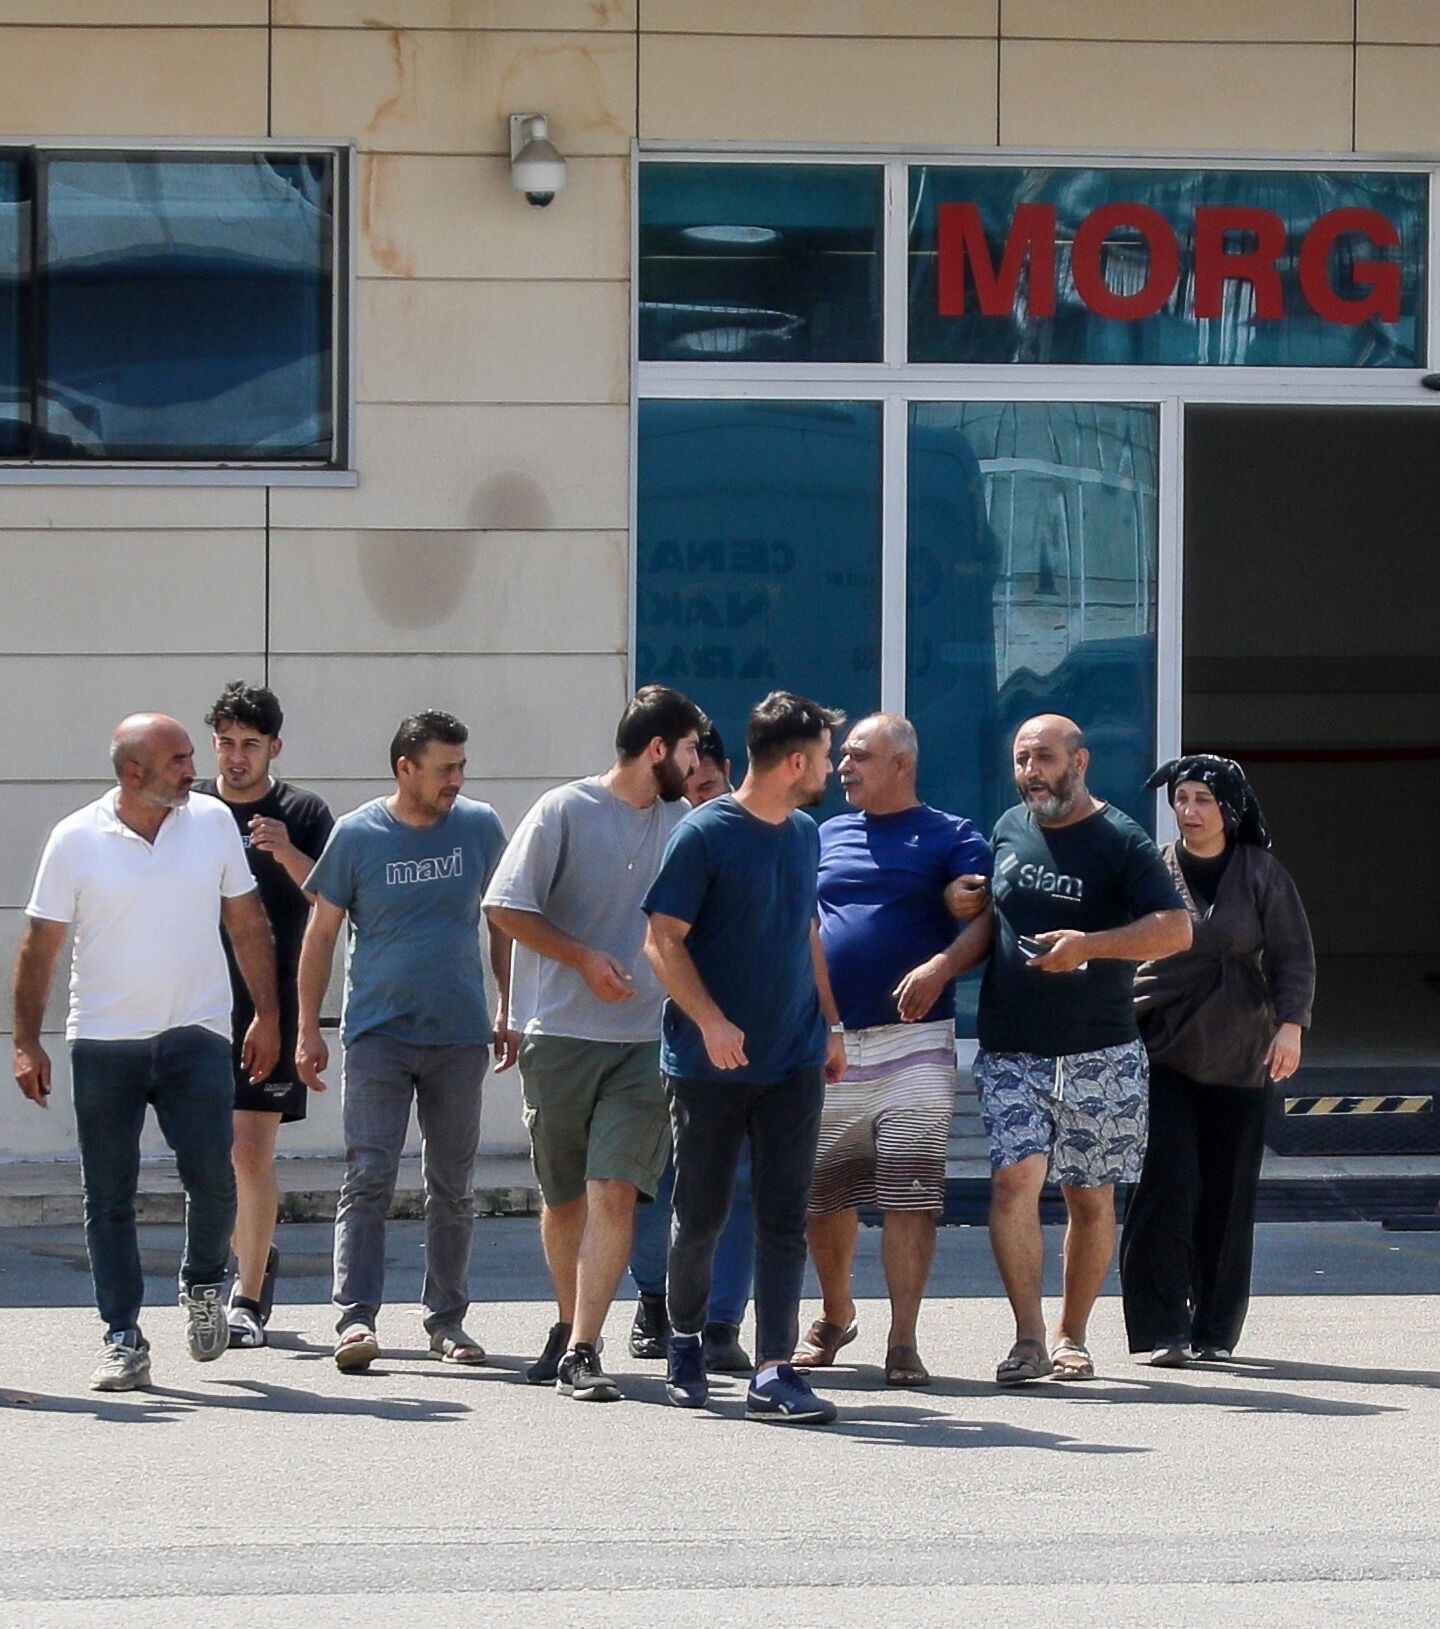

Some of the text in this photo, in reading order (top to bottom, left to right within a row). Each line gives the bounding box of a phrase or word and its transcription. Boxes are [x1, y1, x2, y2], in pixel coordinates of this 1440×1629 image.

[938, 202, 1401, 325] MORG
[386, 847, 463, 885] mavi
[1018, 864, 1082, 897] Slam
